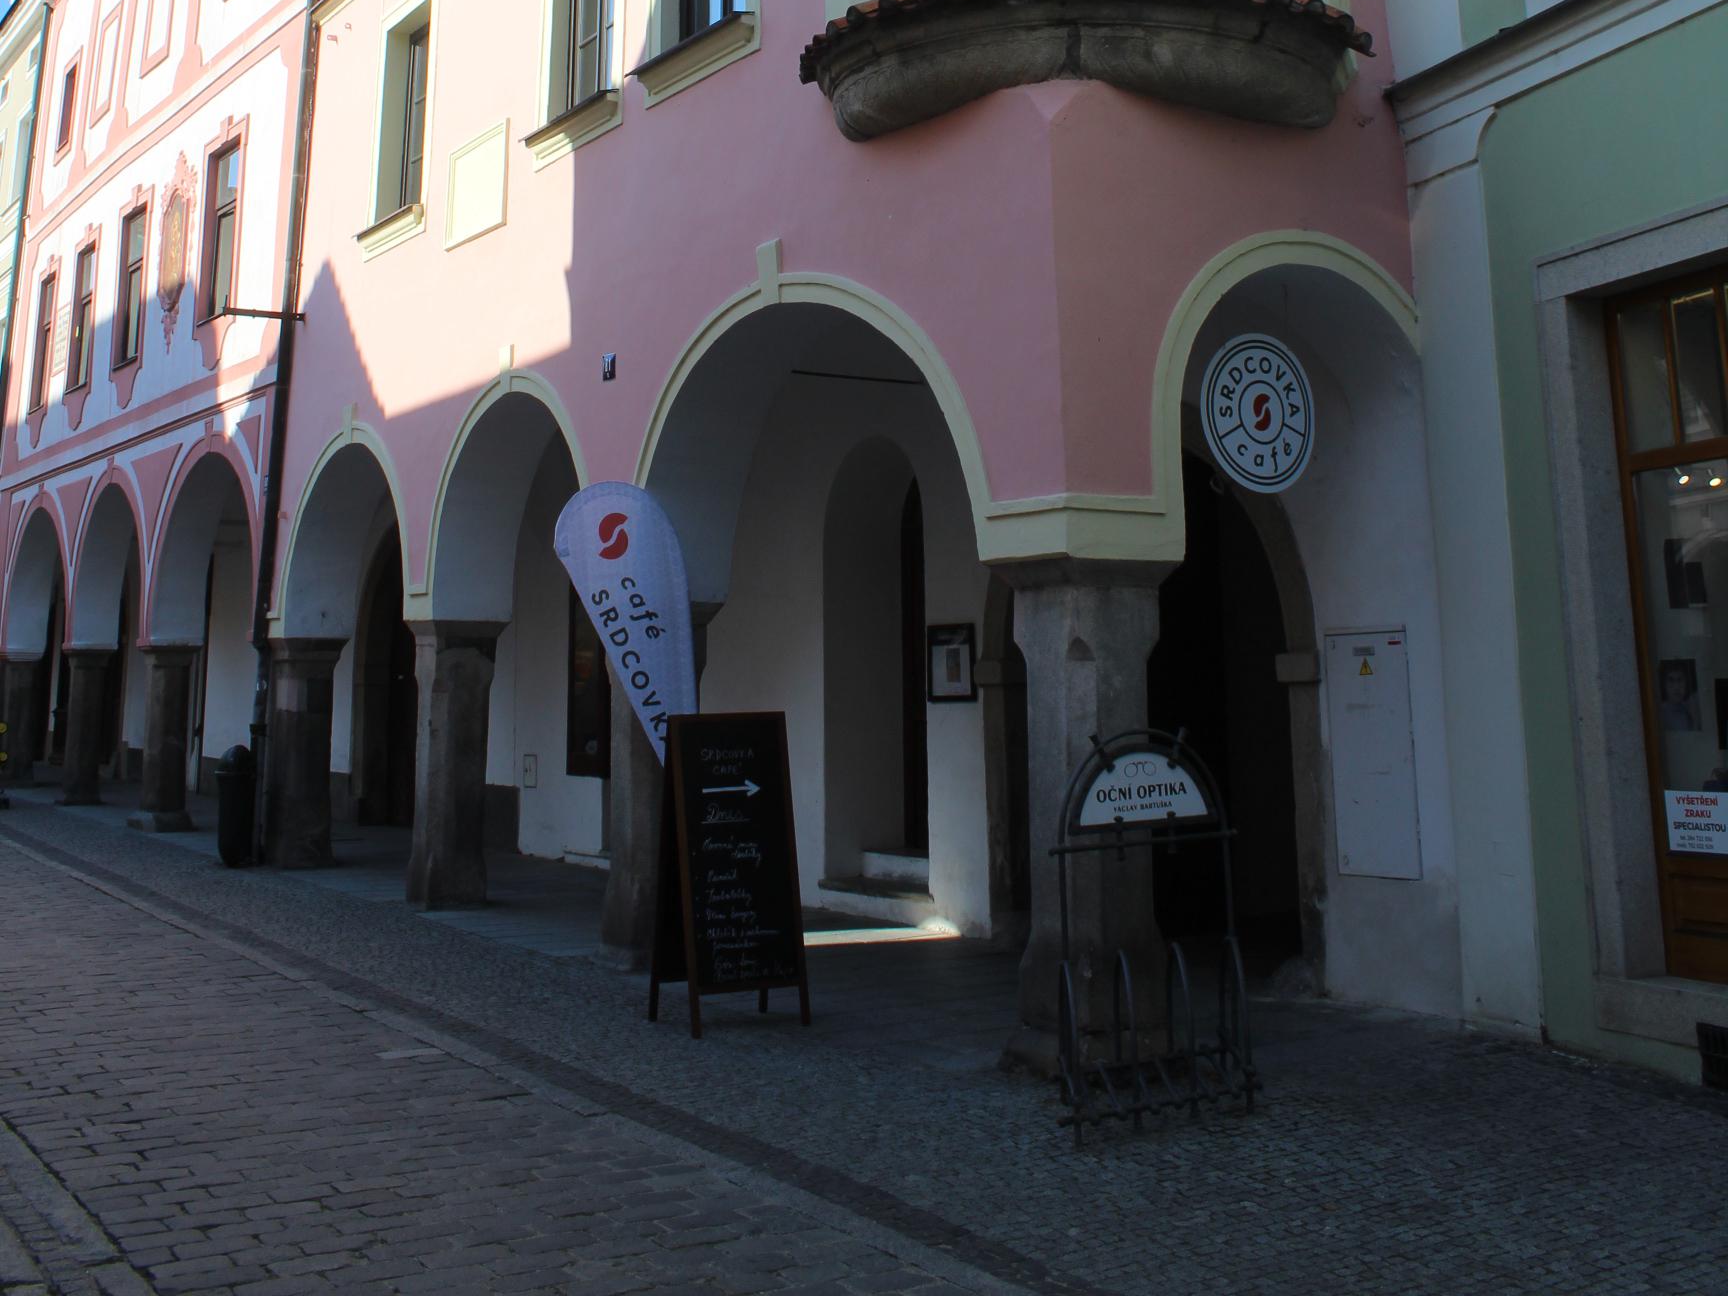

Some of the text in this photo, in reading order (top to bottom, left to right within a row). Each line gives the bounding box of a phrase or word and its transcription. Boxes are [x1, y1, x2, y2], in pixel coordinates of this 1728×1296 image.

[1219, 356, 1301, 418] SRDCOVKA
[1236, 438, 1293, 473] café
[620, 576, 667, 640] café
[591, 589, 669, 746] SRDCOVK
[1096, 781, 1187, 803] OČNÍ OPTIKA
[1675, 794, 1718, 807] VYŠETŘENÍ
[1673, 821, 1726, 832] SPECIALISTOU
[1684, 809, 1712, 818] ZRAKU
